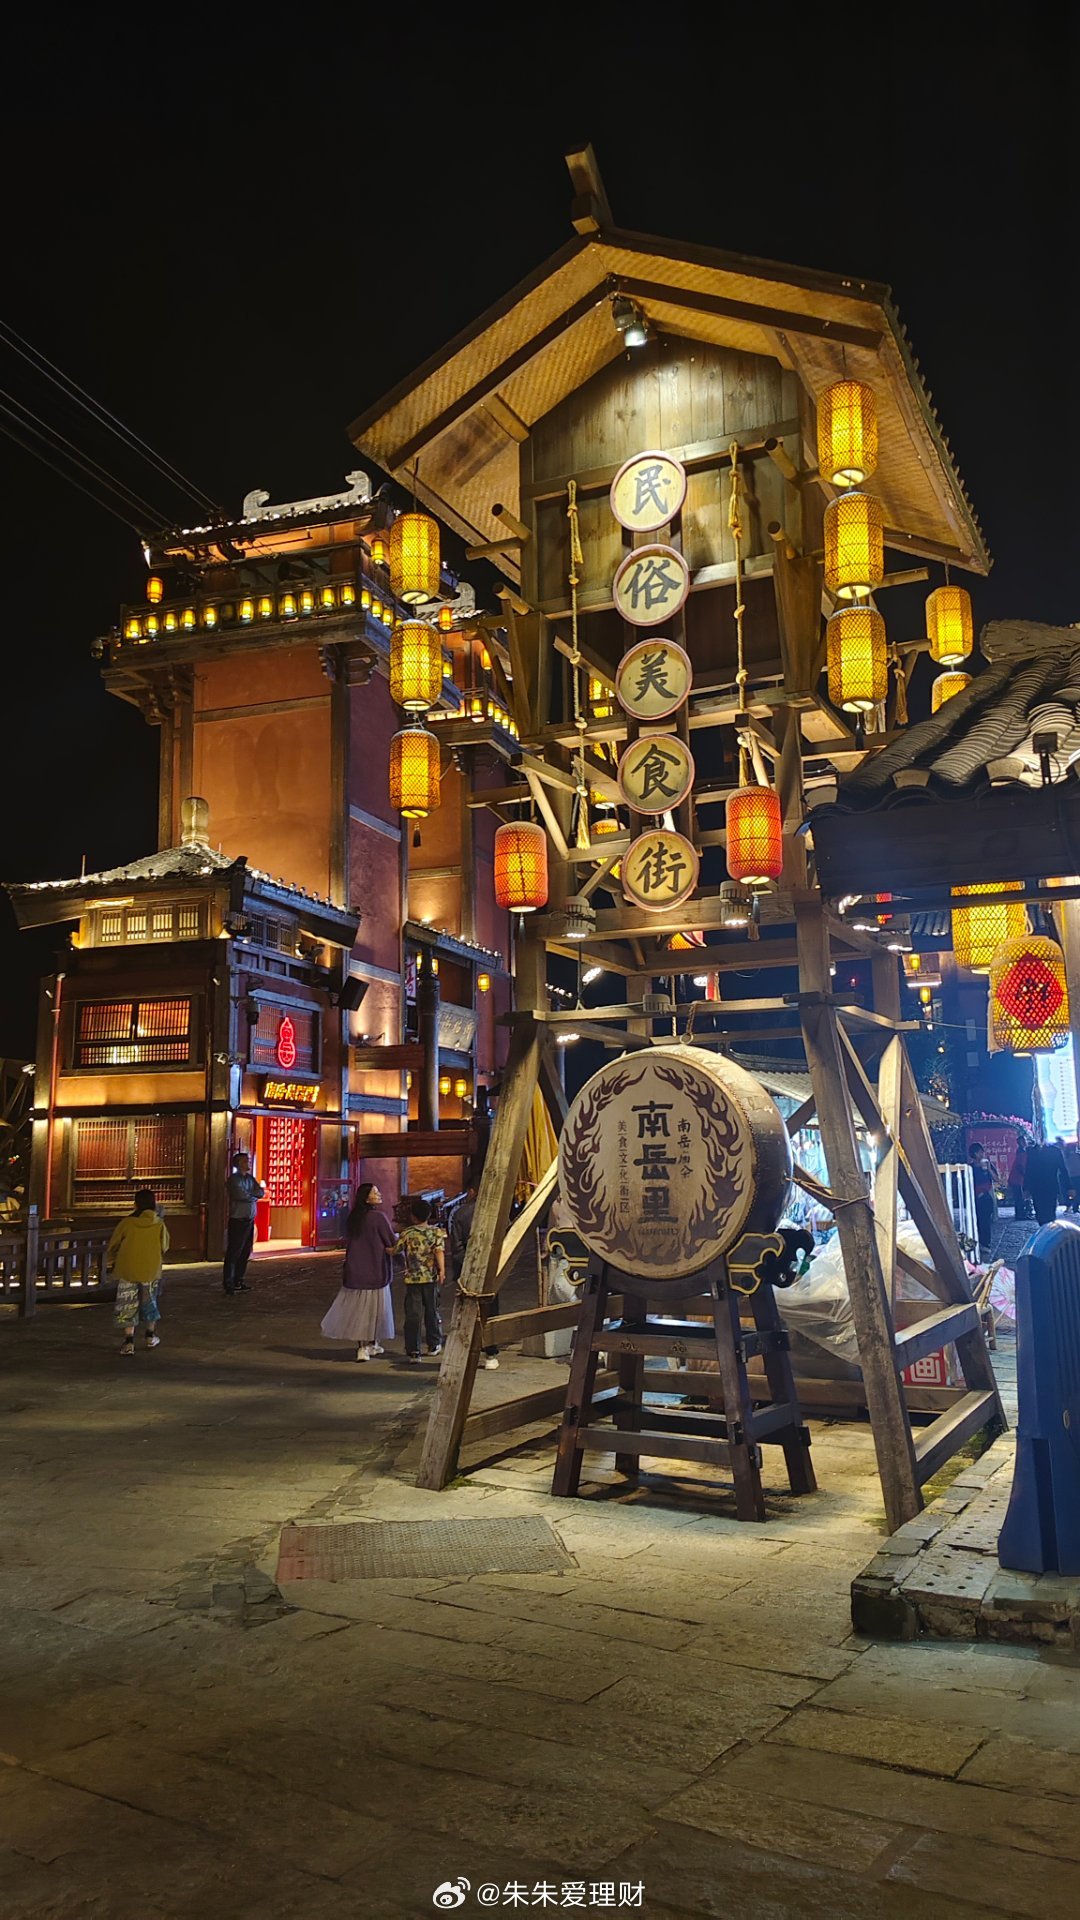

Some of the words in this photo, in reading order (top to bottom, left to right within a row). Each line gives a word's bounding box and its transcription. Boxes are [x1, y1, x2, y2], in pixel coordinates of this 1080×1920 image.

[624, 463, 686, 894] 民俗美食街
[631, 1100, 679, 1224] 南岳里
[900, 1352, 941, 1384] 画
